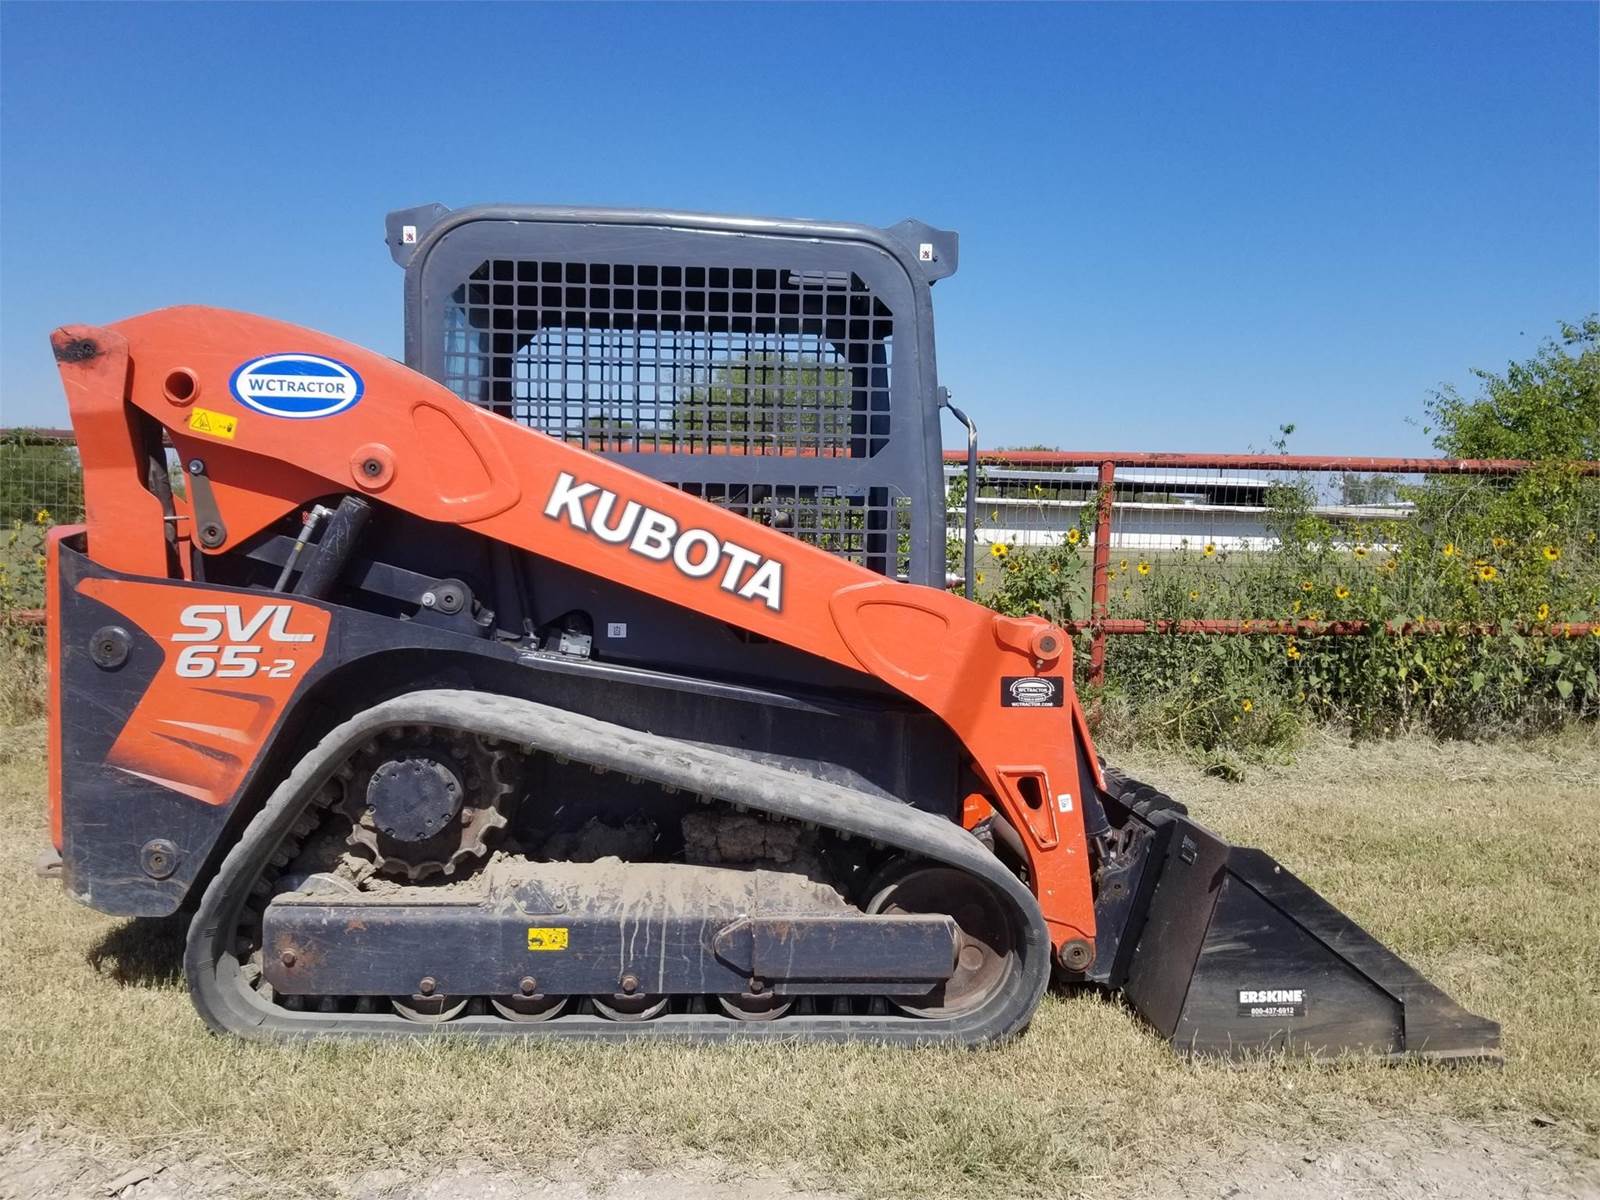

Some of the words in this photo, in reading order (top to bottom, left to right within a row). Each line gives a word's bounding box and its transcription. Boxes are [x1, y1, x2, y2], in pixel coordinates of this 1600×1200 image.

[543, 471, 782, 611] KUBOTA
[171, 605, 316, 642] SVL
[175, 645, 296, 678] 65-2
[1239, 989, 1303, 1003] ERSKINE
